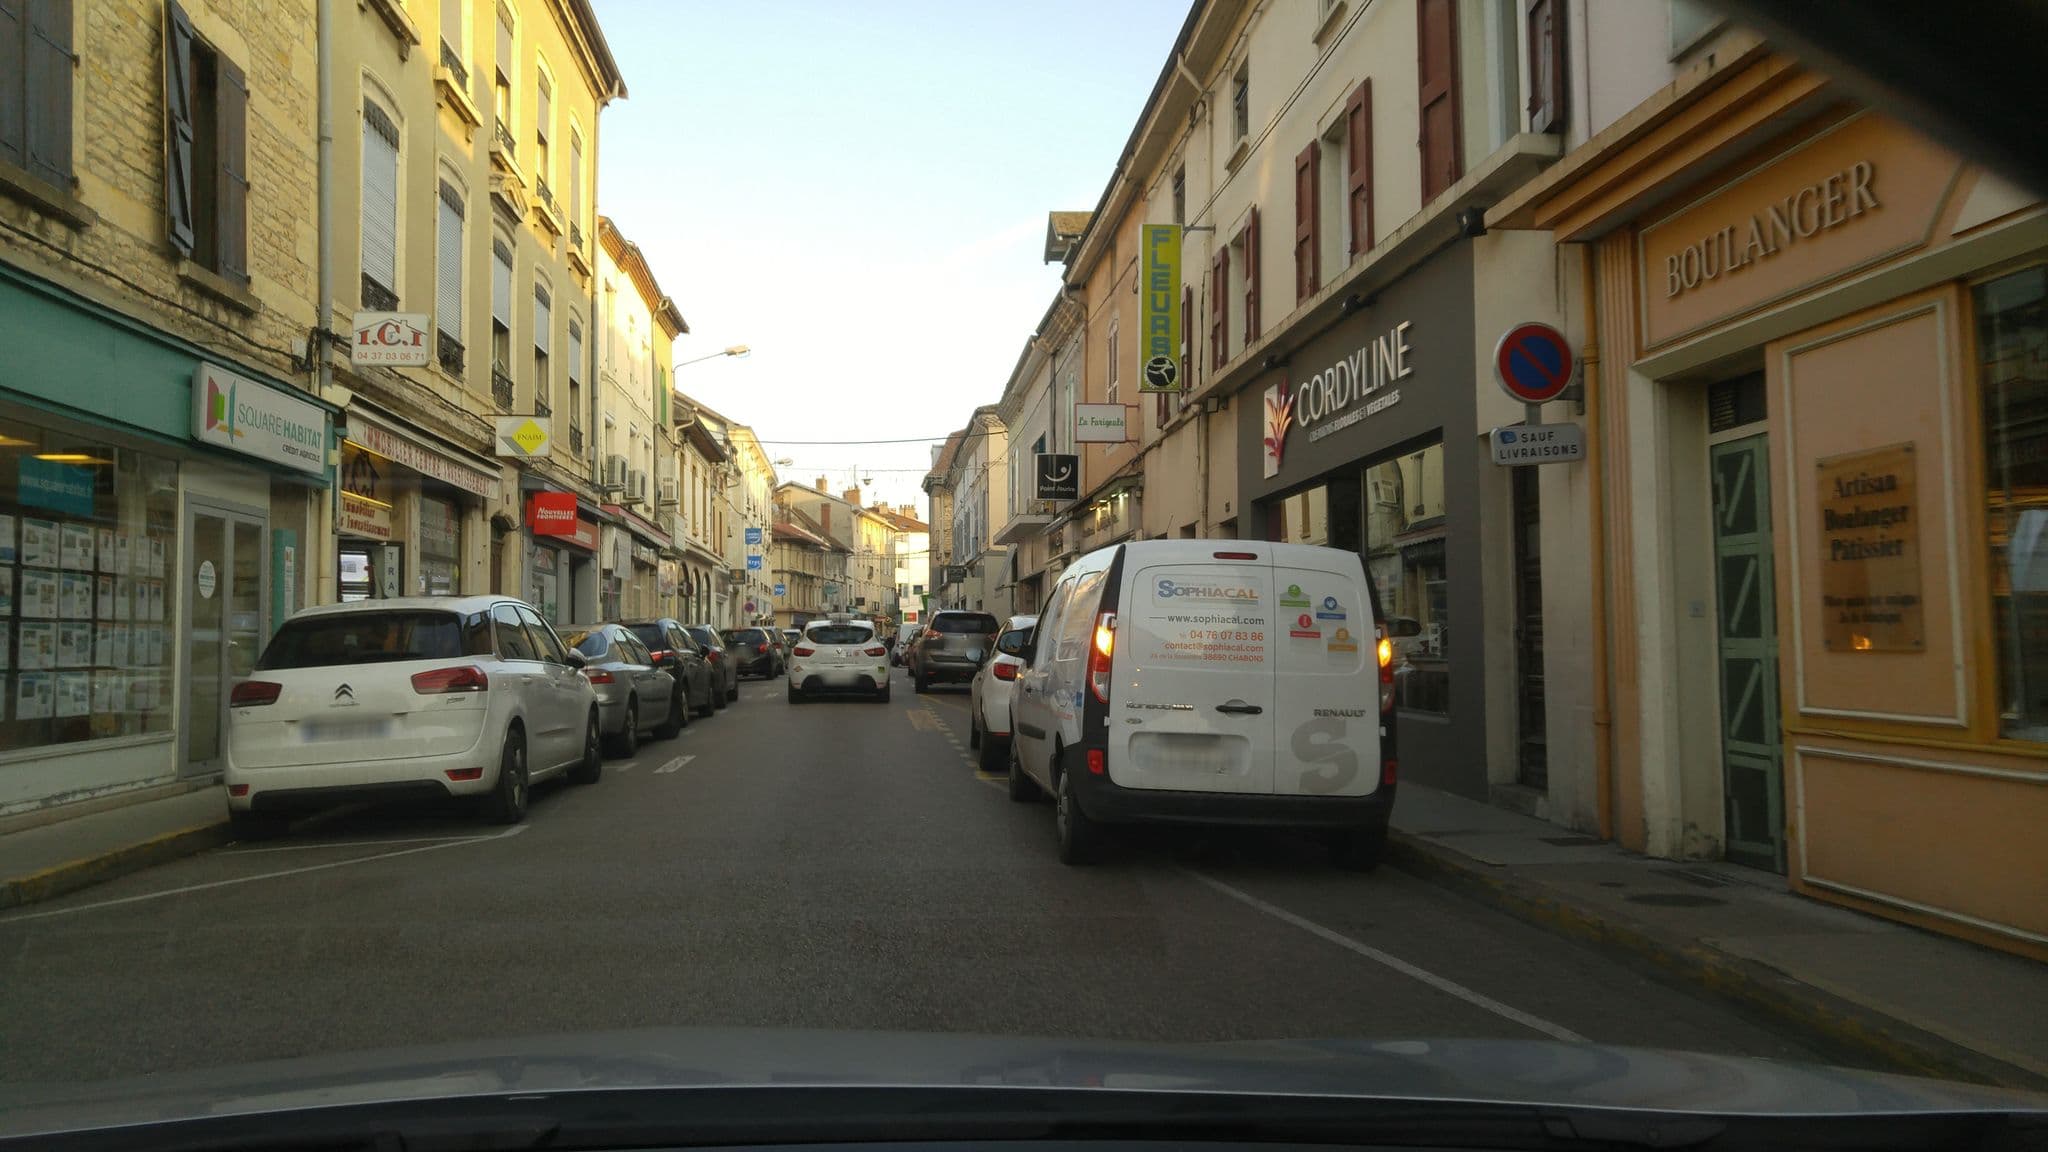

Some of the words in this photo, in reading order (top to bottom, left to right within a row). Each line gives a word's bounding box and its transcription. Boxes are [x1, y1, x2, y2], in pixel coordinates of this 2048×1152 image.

[1666, 160, 1878, 298] BOULANGER
[1151, 229, 1172, 356] FLEURS
[358, 321, 423, 347] I.C.I
[357, 351, 368, 360] 04
[371, 352, 382, 360] 37
[1298, 320, 1413, 427] CORDYLINE
[238, 403, 282, 436] SQUARE
[283, 420, 322, 449] HABITAT
[517, 433, 543, 442] FNAIM
[1521, 431, 1555, 443] SAUF
[1500, 445, 1578, 460] LIVRAISONS
[1833, 472, 1898, 498] Artisan
[1824, 505, 1909, 532] Boulanger
[1167, 613, 1265, 626] www.sophiacal.com
[1190, 629, 1203, 639] 04
[1205, 630, 1218, 640] 76
[1220, 631, 1233, 640] 07
[1235, 631, 1249, 641] 83
[1250, 632, 1264, 641] 86
[1164, 641, 1264, 654] contact@sophiacal.com
[1228, 654, 1264, 663] CHABONS
[1314, 709, 1366, 718] RENAULT
